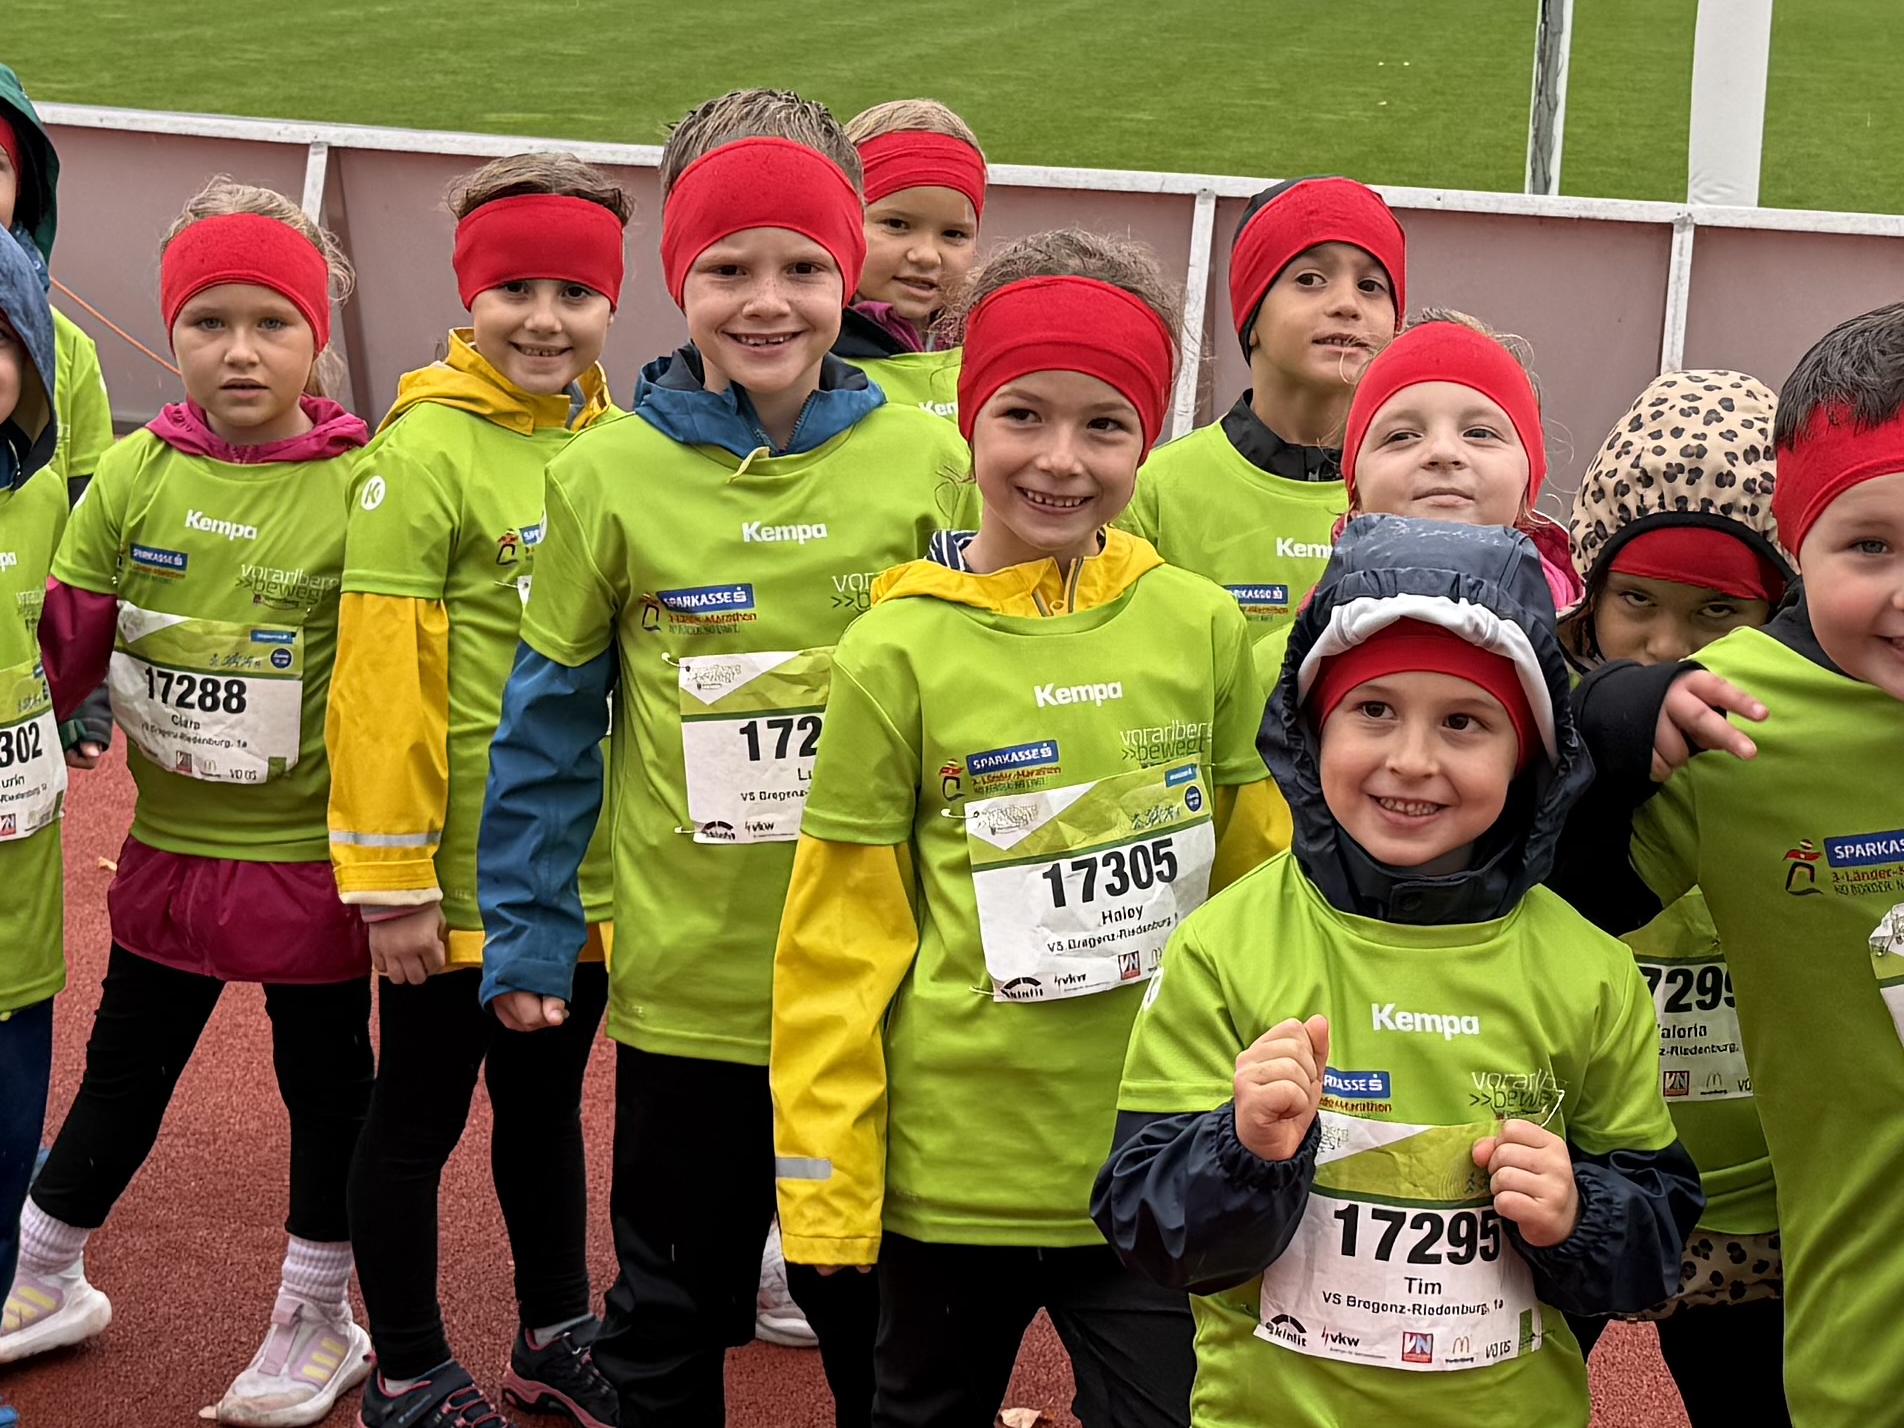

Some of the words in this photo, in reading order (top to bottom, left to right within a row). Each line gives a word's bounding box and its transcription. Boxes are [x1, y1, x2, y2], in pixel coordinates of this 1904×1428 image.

[185, 509, 257, 540] Kempa
[742, 521, 827, 544] Kempa
[663, 590, 733, 610] SPARKASSE
[145, 667, 248, 714] 17288
[1034, 680, 1123, 708] Kempa
[972, 748, 1041, 770] SPARKASSE
[1042, 838, 1179, 909] 17305
[1101, 905, 1144, 927] Haley
[1372, 1003, 1480, 1040] Kempa
[1657, 1024, 1707, 1039] aleria
[1333, 1203, 1501, 1266] 17295
[1404, 1275, 1442, 1296] Tim
[1322, 1290, 1342, 1307] VS
[1329, 1330, 1360, 1348] vkw
